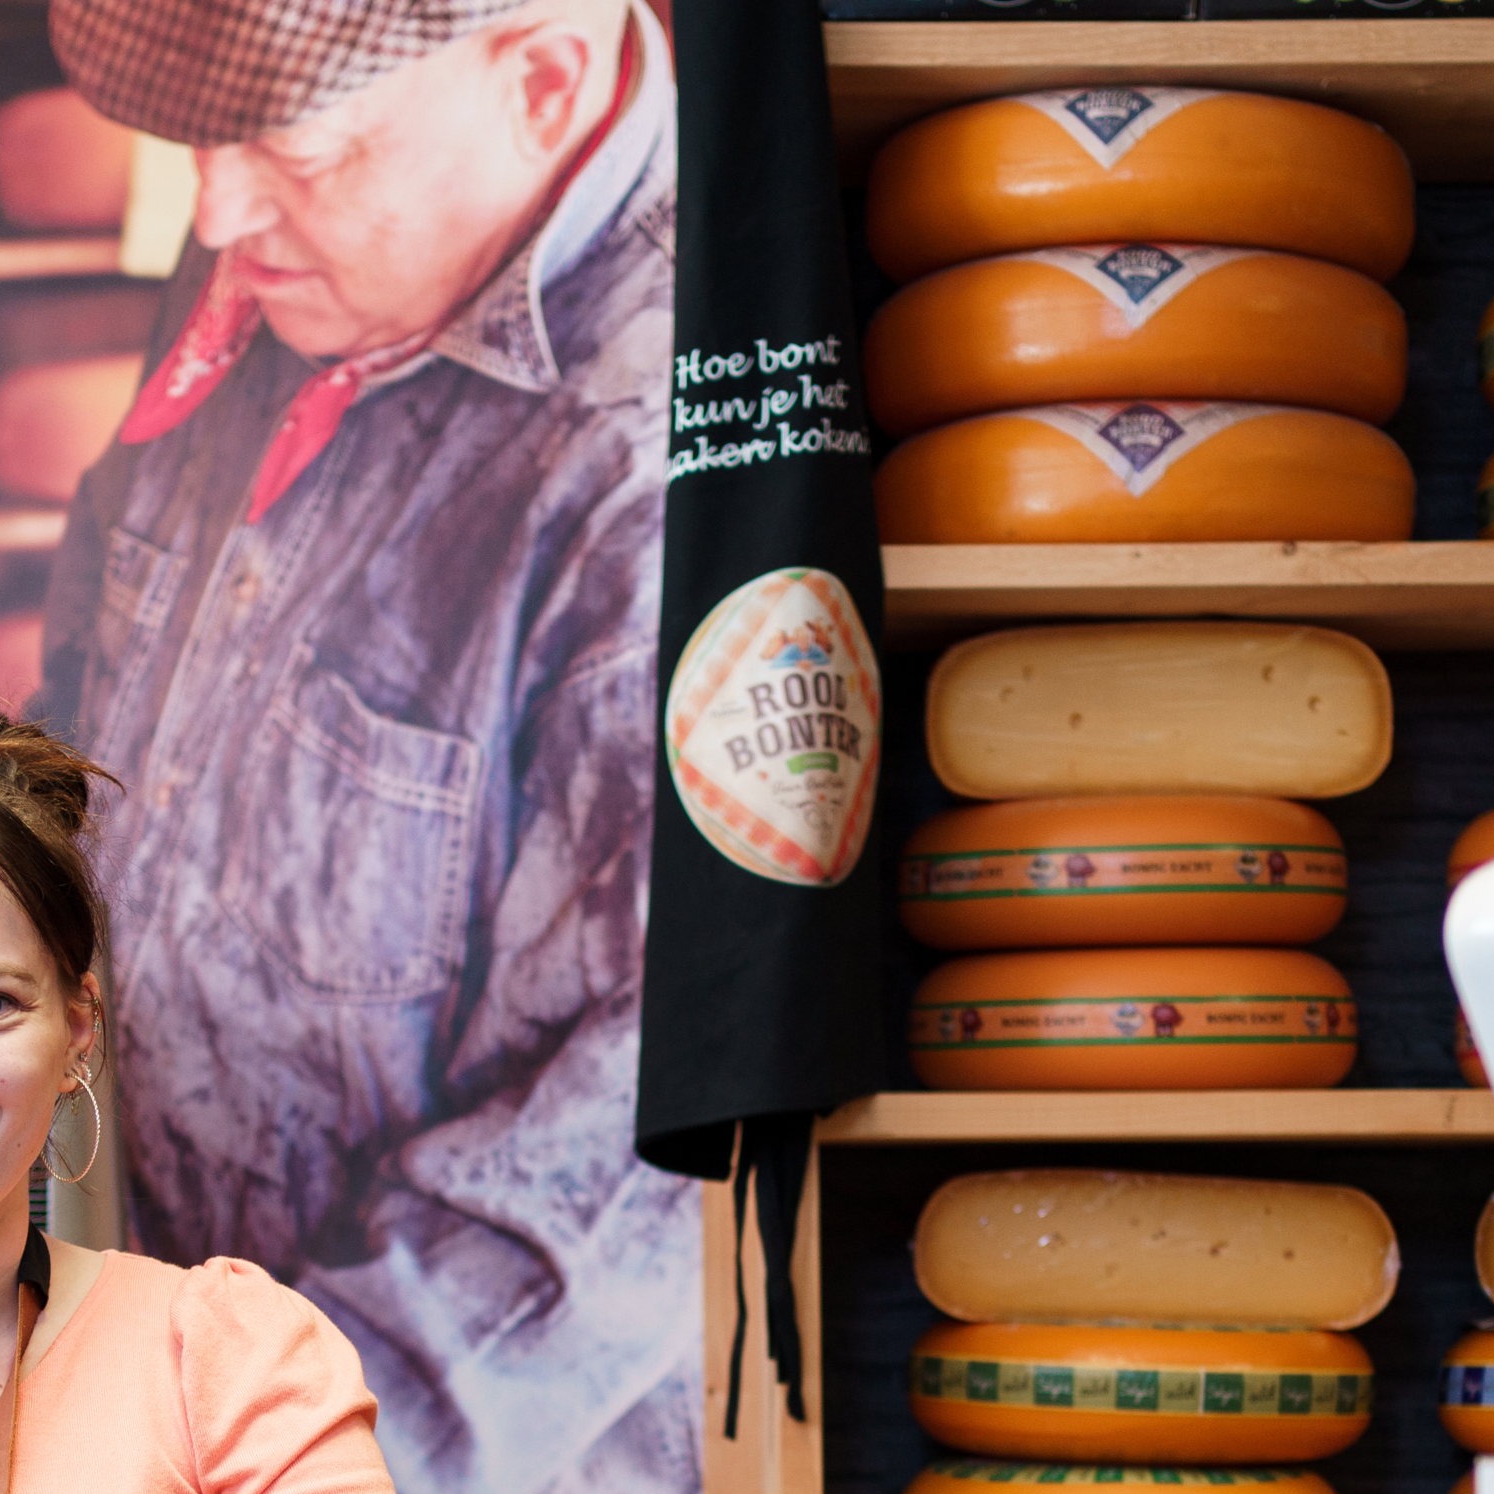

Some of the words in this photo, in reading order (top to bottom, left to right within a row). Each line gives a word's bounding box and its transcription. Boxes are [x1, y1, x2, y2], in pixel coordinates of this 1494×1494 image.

[675, 348, 754, 390] Hoe
[754, 334, 841, 374] bont
[672, 396, 757, 433] kun
[753, 386, 799, 431] je
[798, 373, 850, 409] het
[665, 435, 777, 482] aken
[724, 712, 861, 774] BONTER
